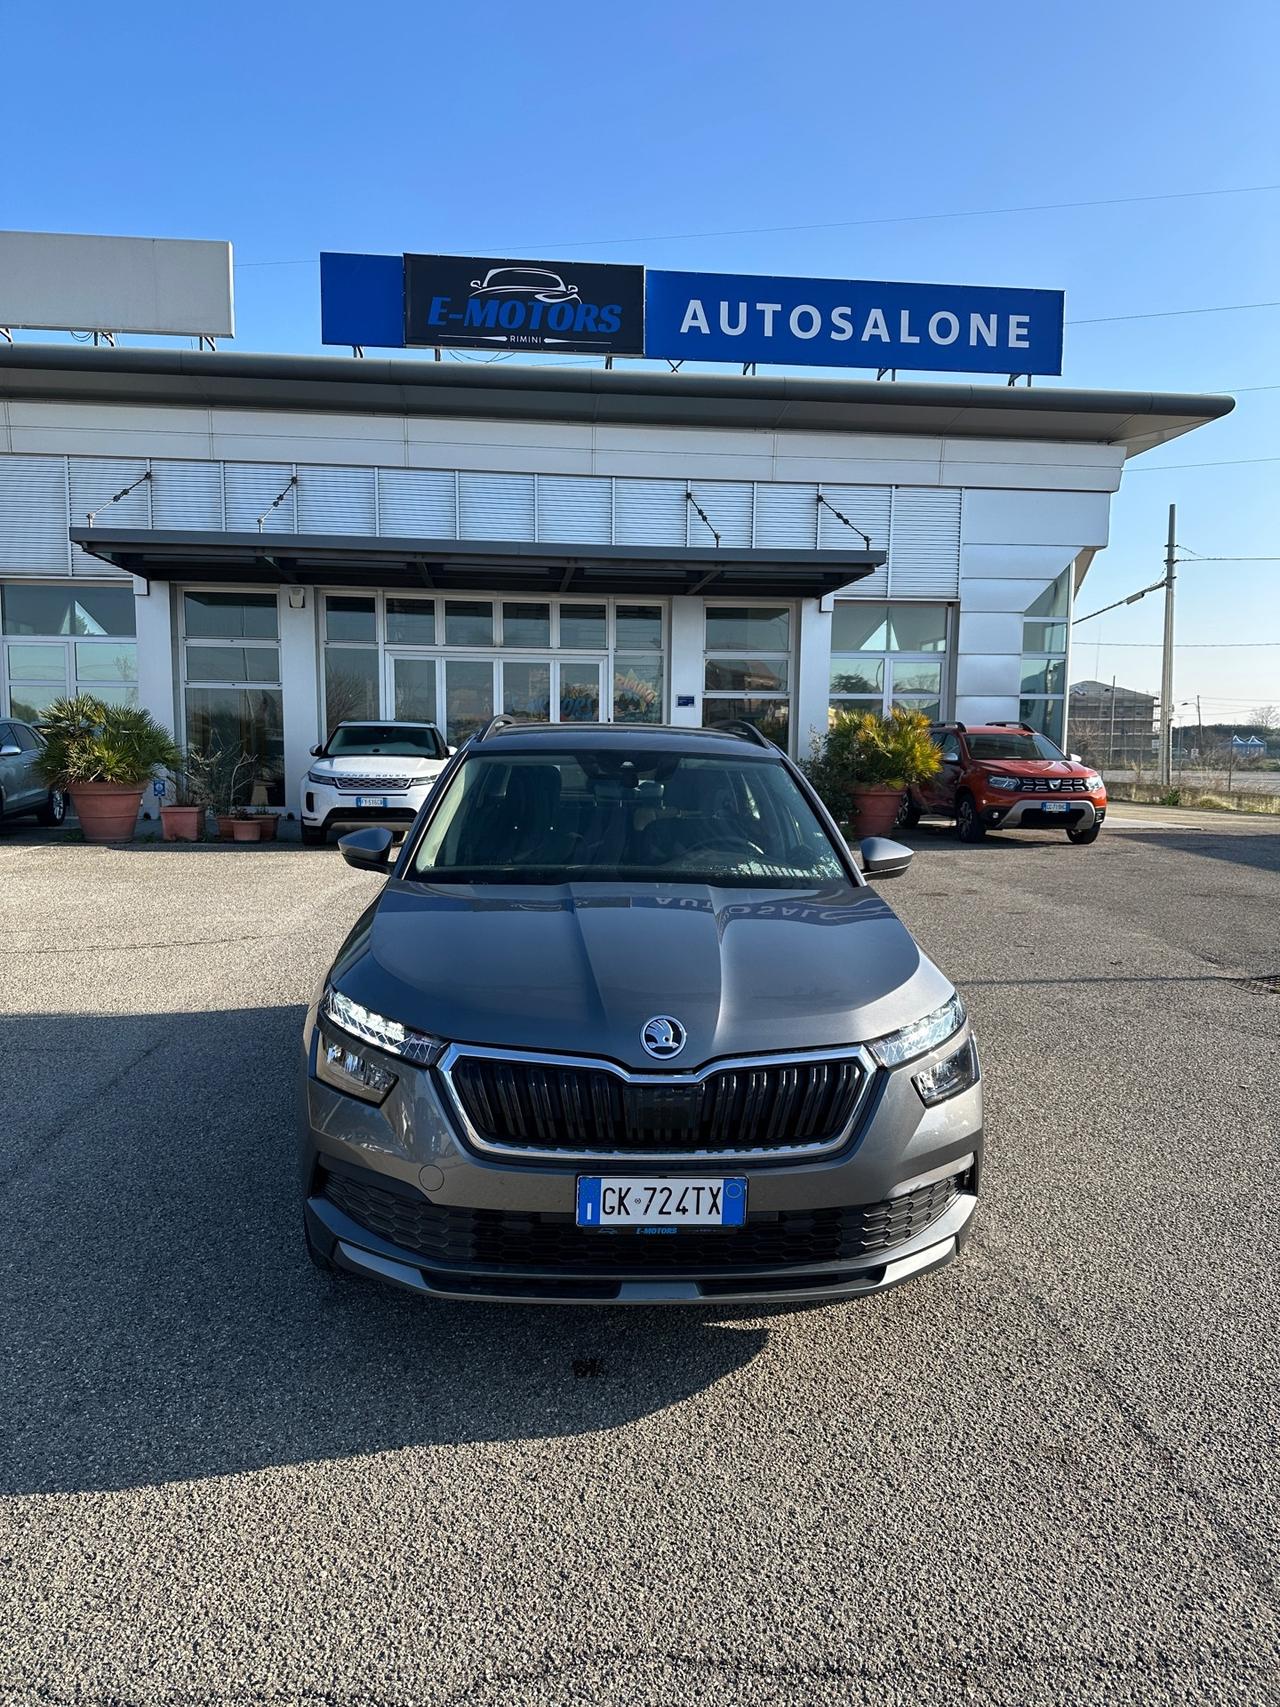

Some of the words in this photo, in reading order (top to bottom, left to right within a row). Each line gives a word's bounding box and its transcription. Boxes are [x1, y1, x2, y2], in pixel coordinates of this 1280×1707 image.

[427, 295, 623, 334] E-MOTORS
[680, 299, 1030, 348] AUTOSALONE
[509, 335, 542, 344] RIMINI
